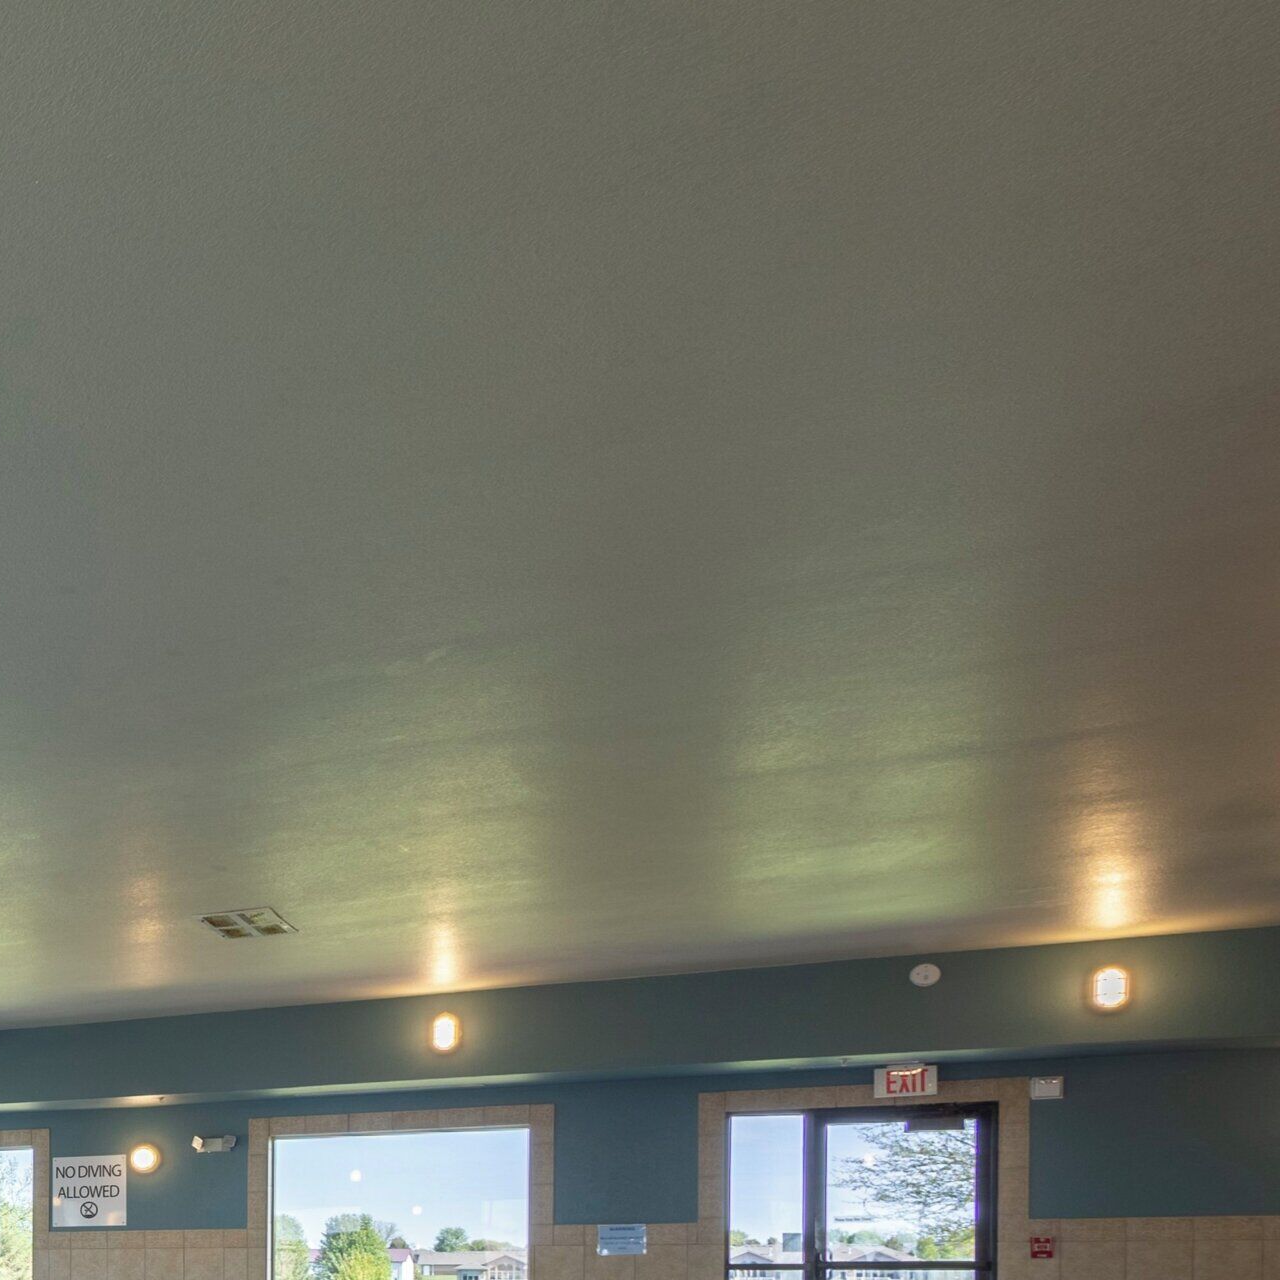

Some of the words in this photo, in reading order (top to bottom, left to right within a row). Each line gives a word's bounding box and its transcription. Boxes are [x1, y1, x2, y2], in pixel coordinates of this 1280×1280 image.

[886, 1068, 928, 1094] EXIT
[56, 1166, 75, 1178] NO
[78, 1164, 121, 1178] DIVING
[58, 1185, 120, 1198] ALLOWED
